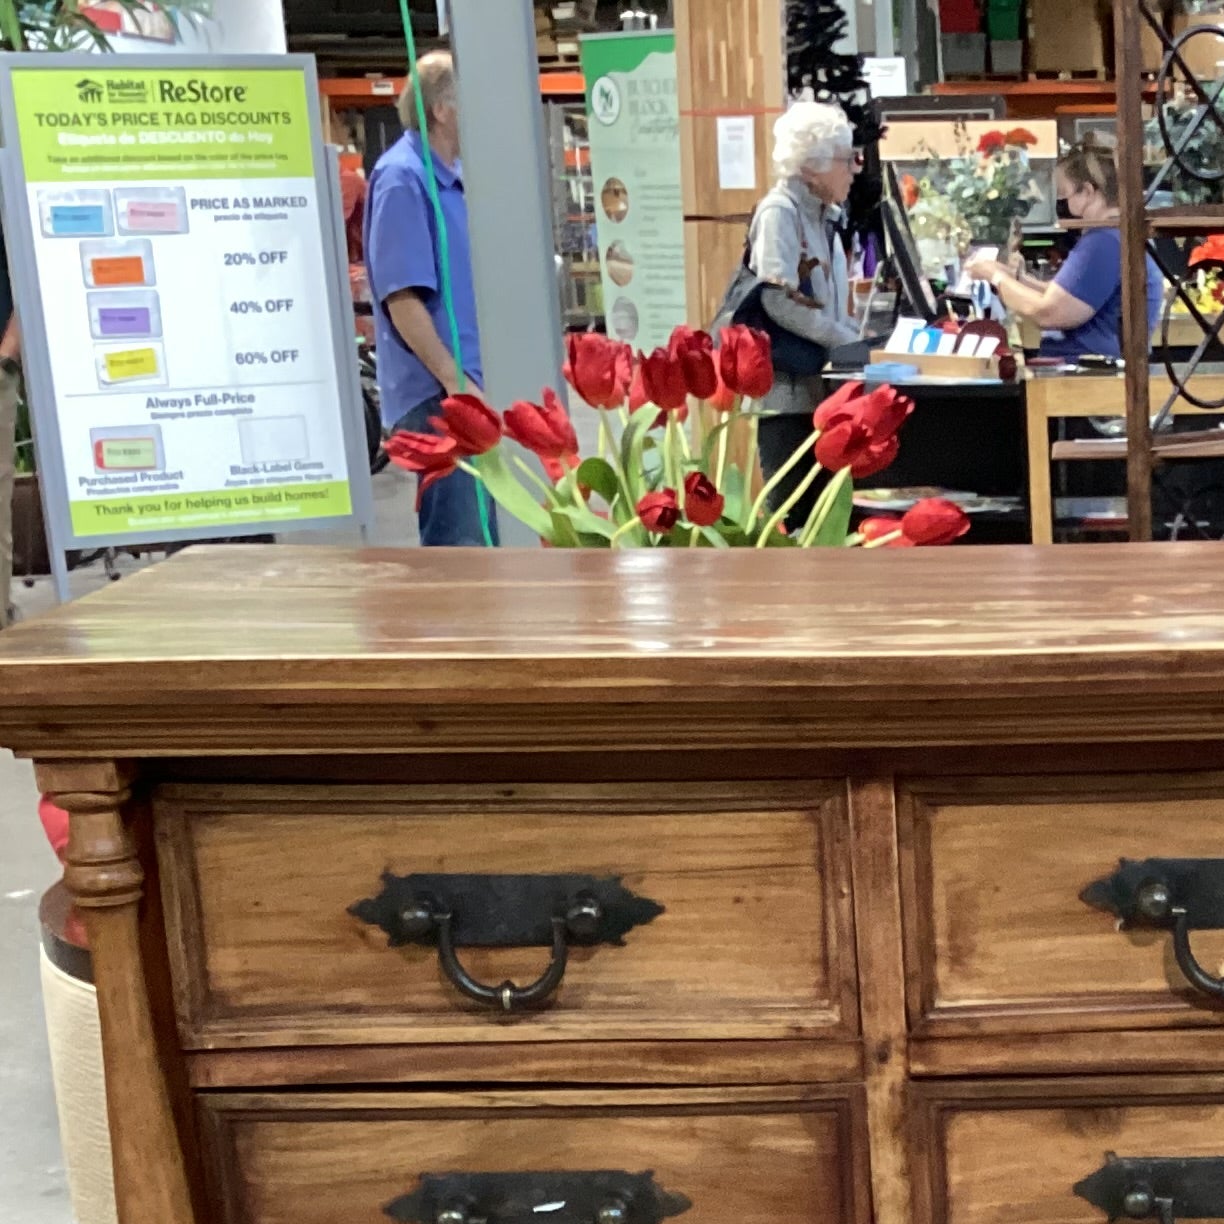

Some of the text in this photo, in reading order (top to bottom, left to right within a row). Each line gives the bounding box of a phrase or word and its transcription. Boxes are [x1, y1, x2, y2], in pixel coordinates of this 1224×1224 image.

[106, 80, 145, 90] Habitat
[159, 79, 245, 103] ReStore
[34, 111, 292, 127] TODAY'S PRICE TAG DISCOUNTS
[138, 130, 226, 144] DESCUENTO
[190, 196, 308, 210] PRICE AS MARKED
[223, 250, 288, 266] 20% OFF
[229, 299, 294, 314] 40% OFF
[235, 349, 299, 365] 60% OFF
[145, 392, 256, 409] Always Full-Price
[78, 469, 184, 487] Purchased Product
[94, 488, 329, 516] Thank you for helping us build homes!
